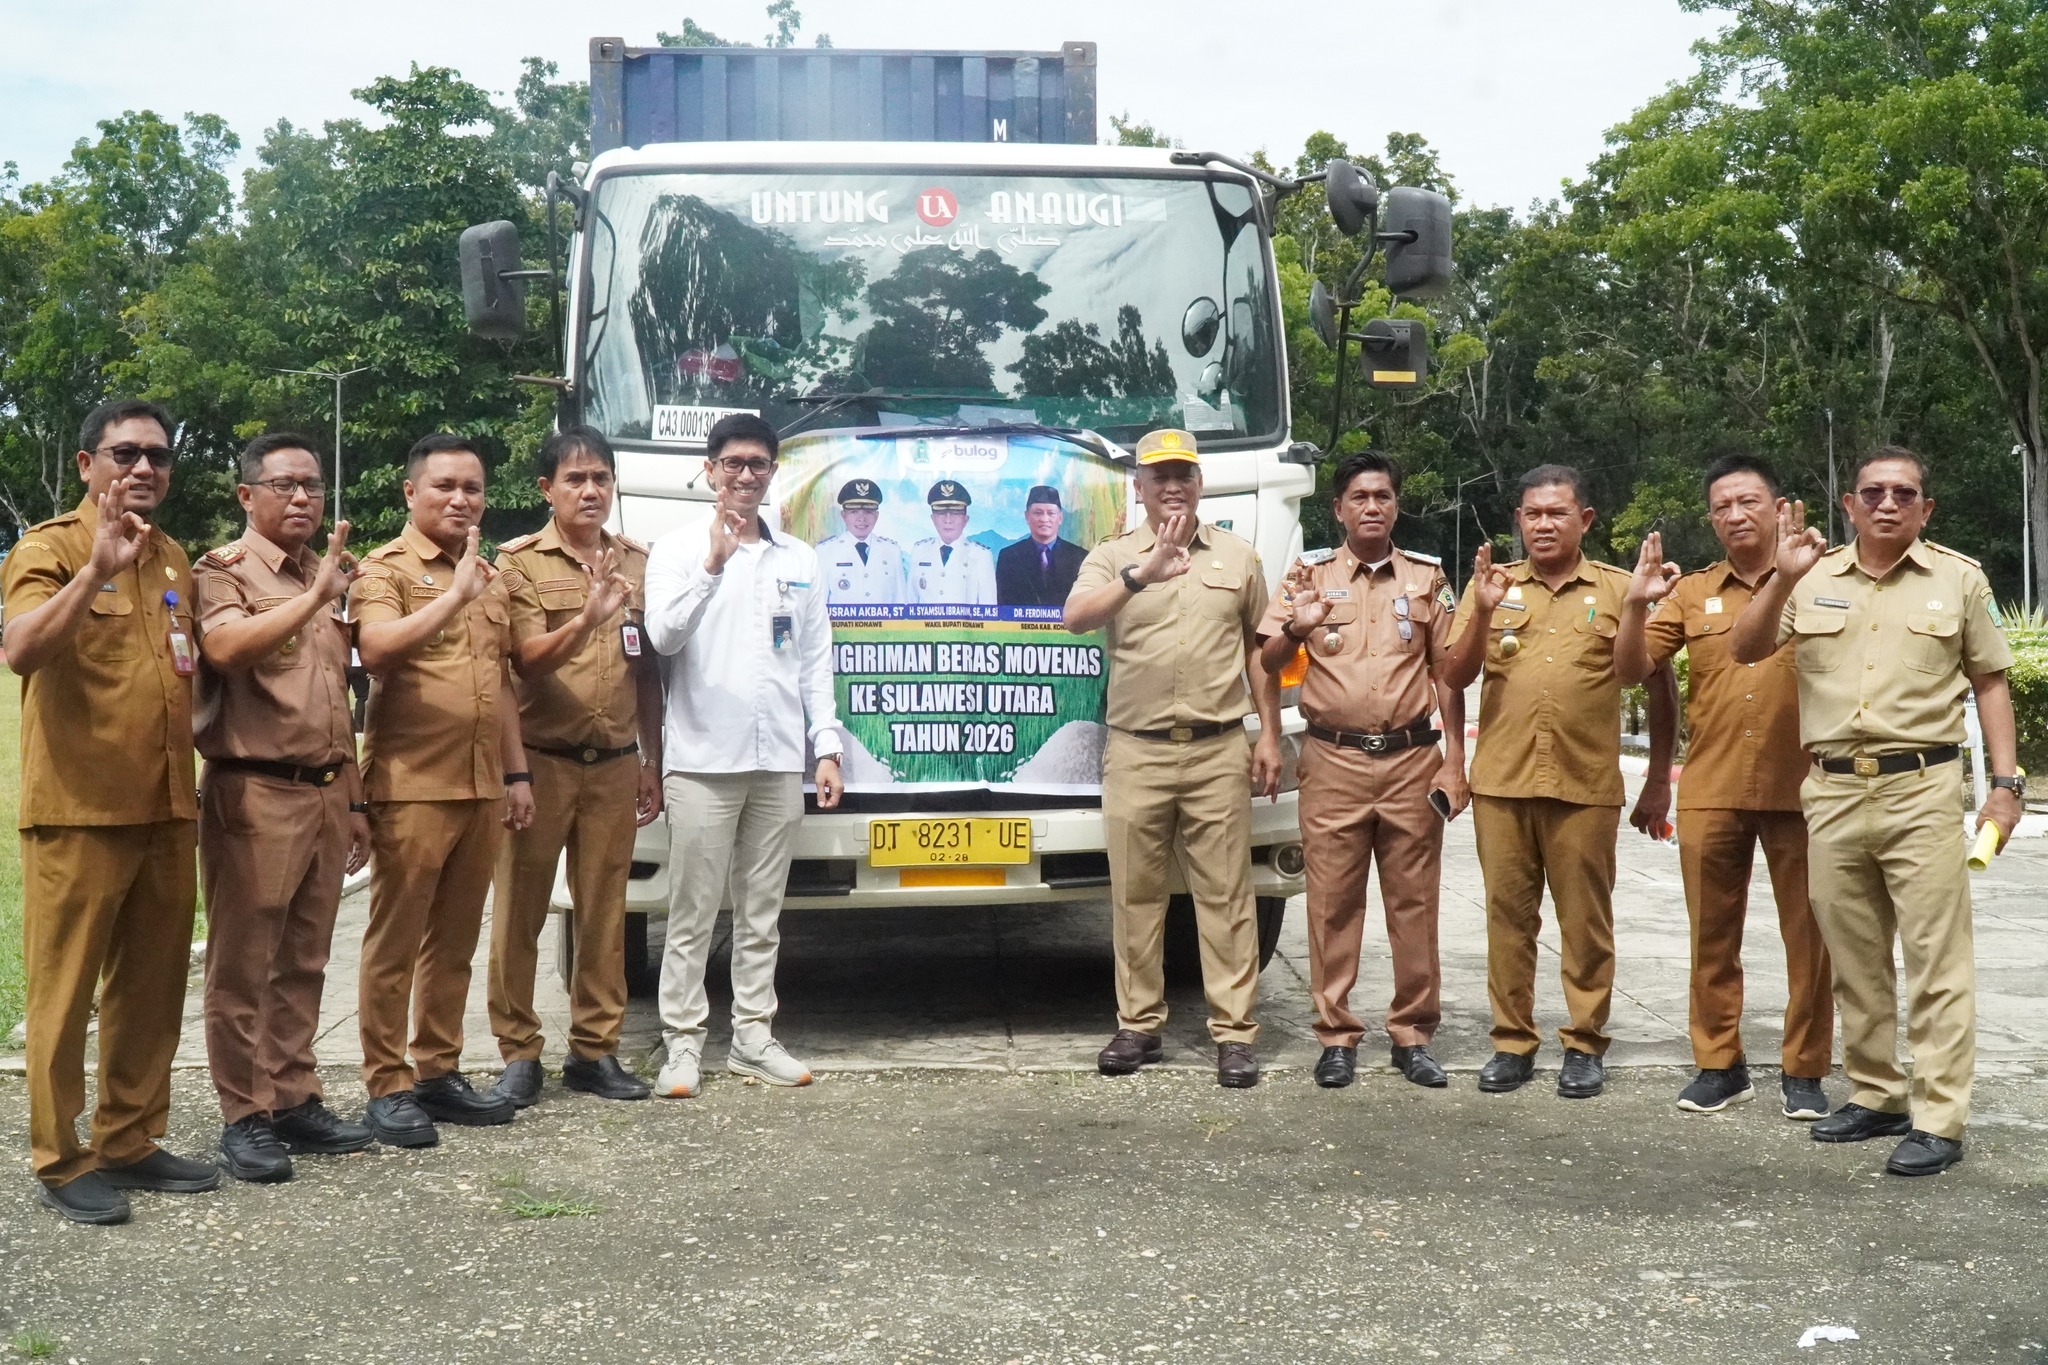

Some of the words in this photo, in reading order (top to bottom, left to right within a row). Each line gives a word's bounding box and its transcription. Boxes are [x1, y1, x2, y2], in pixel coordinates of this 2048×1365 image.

[993, 118, 1007, 142] M
[751, 189, 889, 225] UNTUNG
[920, 195, 954, 219] UA
[984, 191, 1123, 227] ANAUGI
[658, 409, 677, 437] CA3
[954, 444, 998, 460] bulog
[859, 606, 892, 619] AKBAR,
[893, 606, 904, 617] ST
[909, 606, 916, 616] H.
[916, 606, 945, 616] SYAMSUL
[1013, 608, 1024, 618] DR.
[1025, 608, 1062, 620] FERDINAND,
[962, 621, 984, 629] KONAWE
[937, 644, 1000, 674] BERAS
[1005, 645, 1100, 676] MOVENAS
[851, 684, 878, 713] KE
[881, 683, 983, 713] SULAWESI
[988, 685, 1055, 714] UTARA
[891, 723, 961, 752] TAHUN
[964, 723, 1014, 753] 2026
[873, 823, 901, 849] DT
[918, 822, 972, 848] 8231
[1000, 822, 1027, 848] UE
